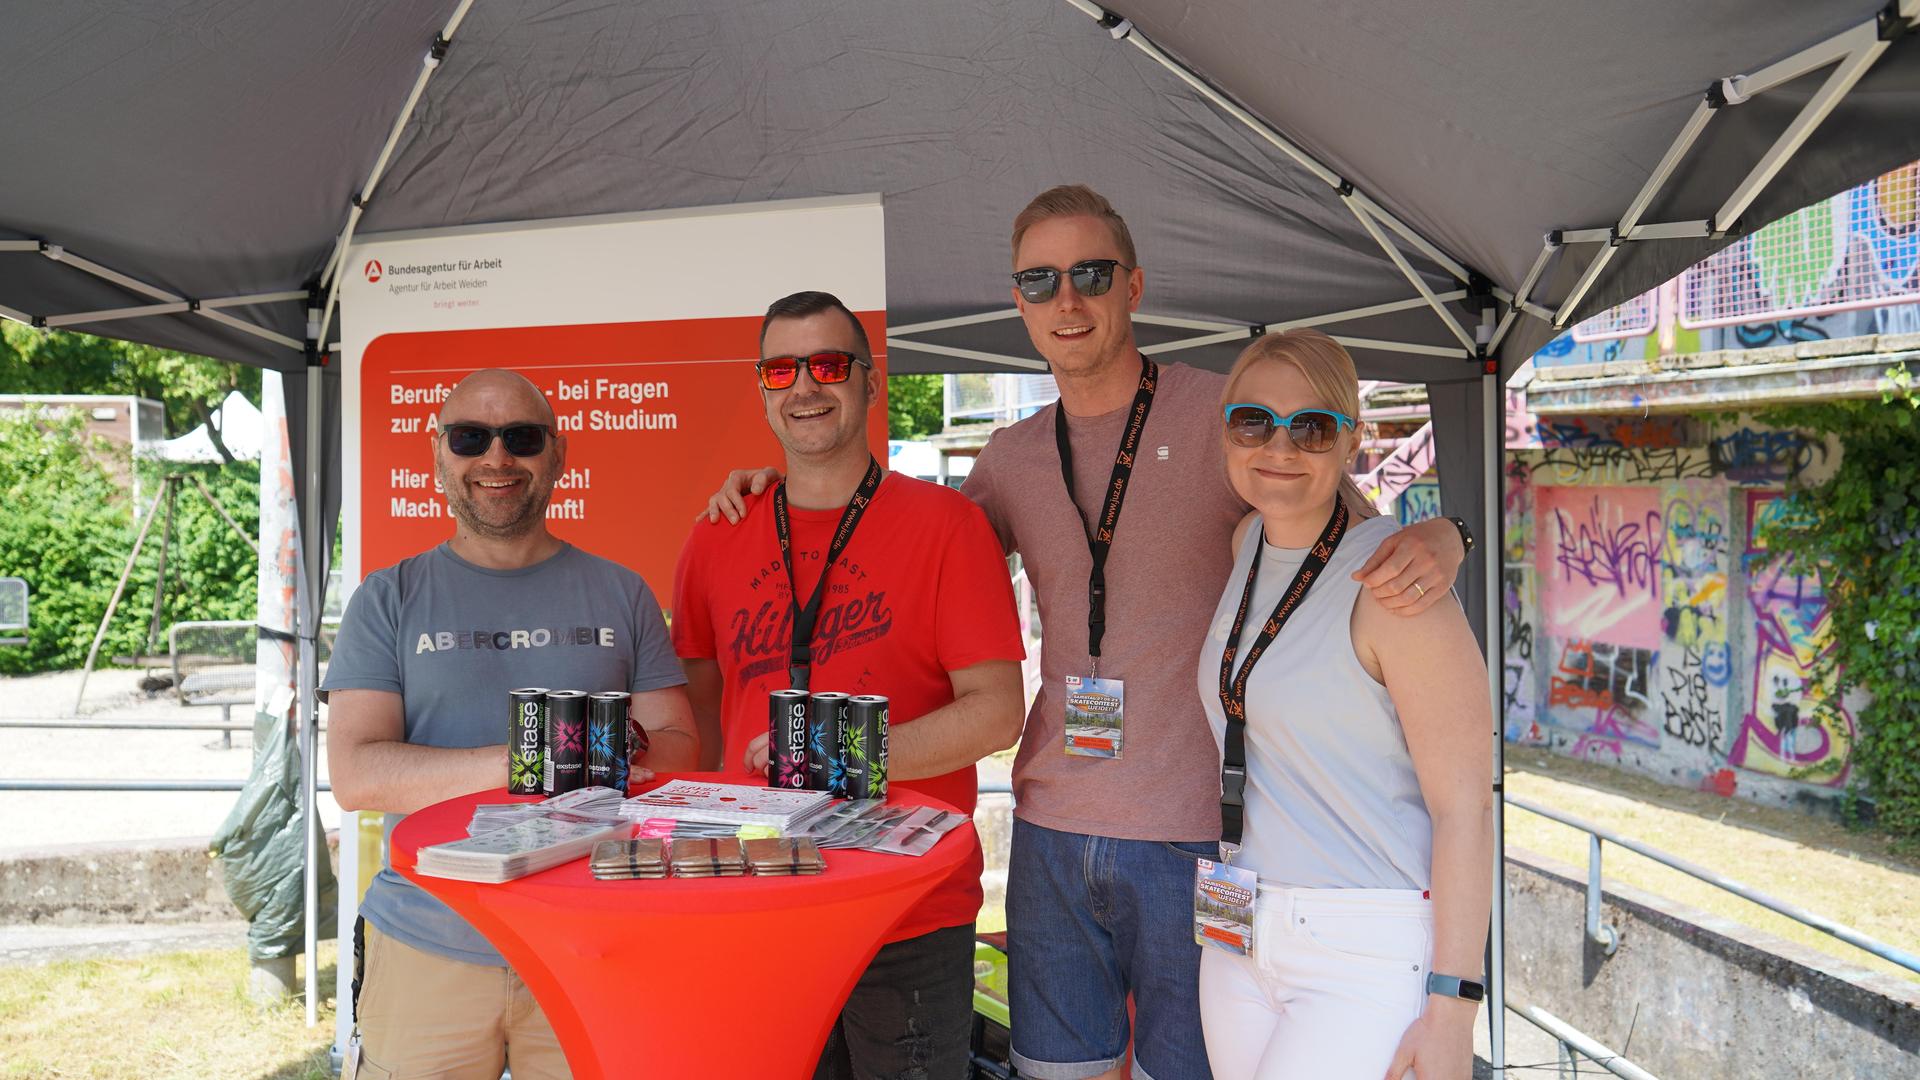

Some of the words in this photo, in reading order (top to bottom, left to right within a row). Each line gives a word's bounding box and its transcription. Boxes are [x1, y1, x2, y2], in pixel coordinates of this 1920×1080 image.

[388, 263, 456, 275] Bundesagentur
[458, 260, 471, 270] für
[473, 258, 502, 269] Arbeit
[389, 283, 418, 295] Agentur
[420, 281, 431, 291] für
[433, 280, 457, 290] Arbeit
[459, 279, 488, 289] Weiden
[433, 301, 455, 309] bringt
[558, 380, 589, 400] bei
[595, 379, 669, 403] Fragen
[391, 416, 421, 433] zur
[557, 411, 583, 432] nd
[589, 409, 677, 430] Studium
[1126, 402, 1146, 449] www.juz.de
[391, 469, 428, 488] Hier
[391, 498, 441, 517] Mach
[1106, 478, 1124, 525] www.juz.de
[833, 508, 858, 550] www.juz.de
[751, 560, 781, 590] MAD
[800, 550, 820, 561] TO
[839, 557, 867, 581] AST
[1277, 570, 1313, 619] www.juz.de
[416, 628, 615, 654] ABERCROMBIE
[1236, 648, 1261, 697] www.juz.de
[1070, 698, 1119, 707] SKATECONTEST
[1200, 883, 1250, 901] SKATECONTEST
